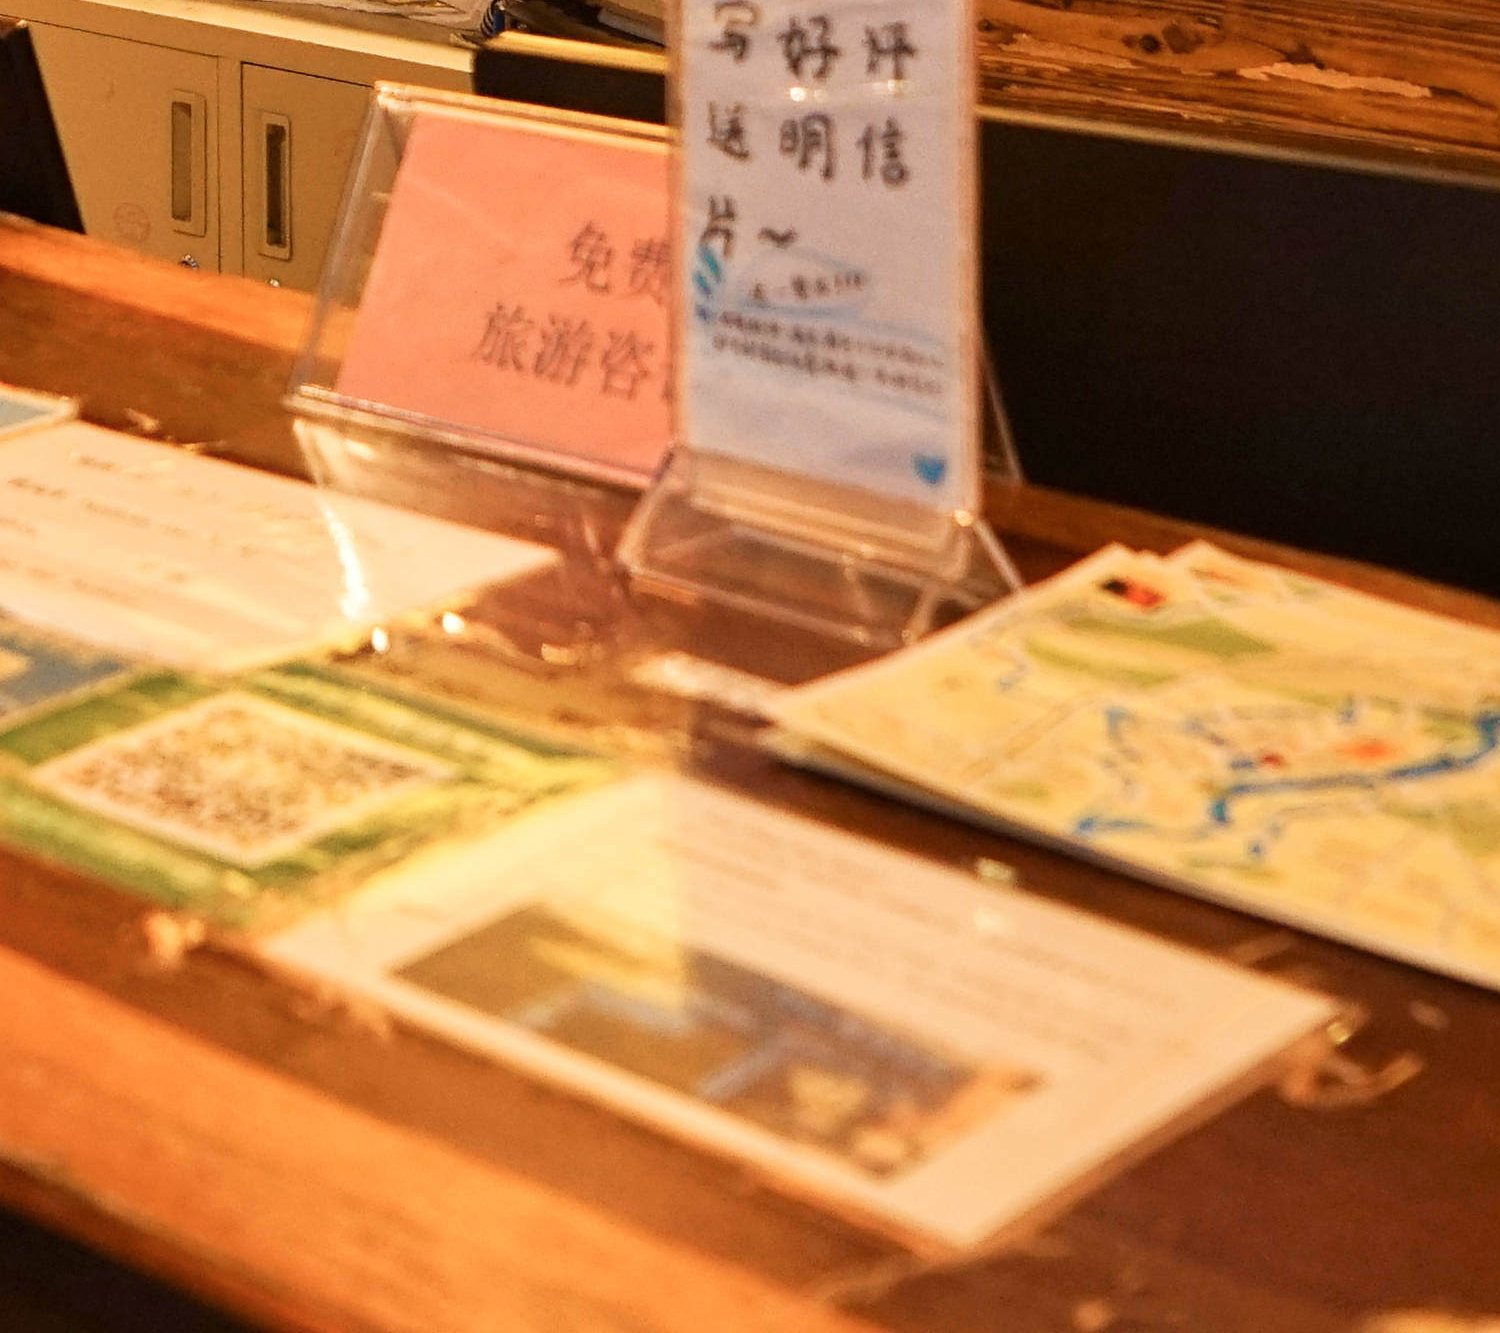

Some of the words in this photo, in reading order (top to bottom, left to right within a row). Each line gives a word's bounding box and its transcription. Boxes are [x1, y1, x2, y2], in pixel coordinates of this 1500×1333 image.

[709, 0, 916, 82] 写好评
[472, 303, 676, 402] 旅游咨
